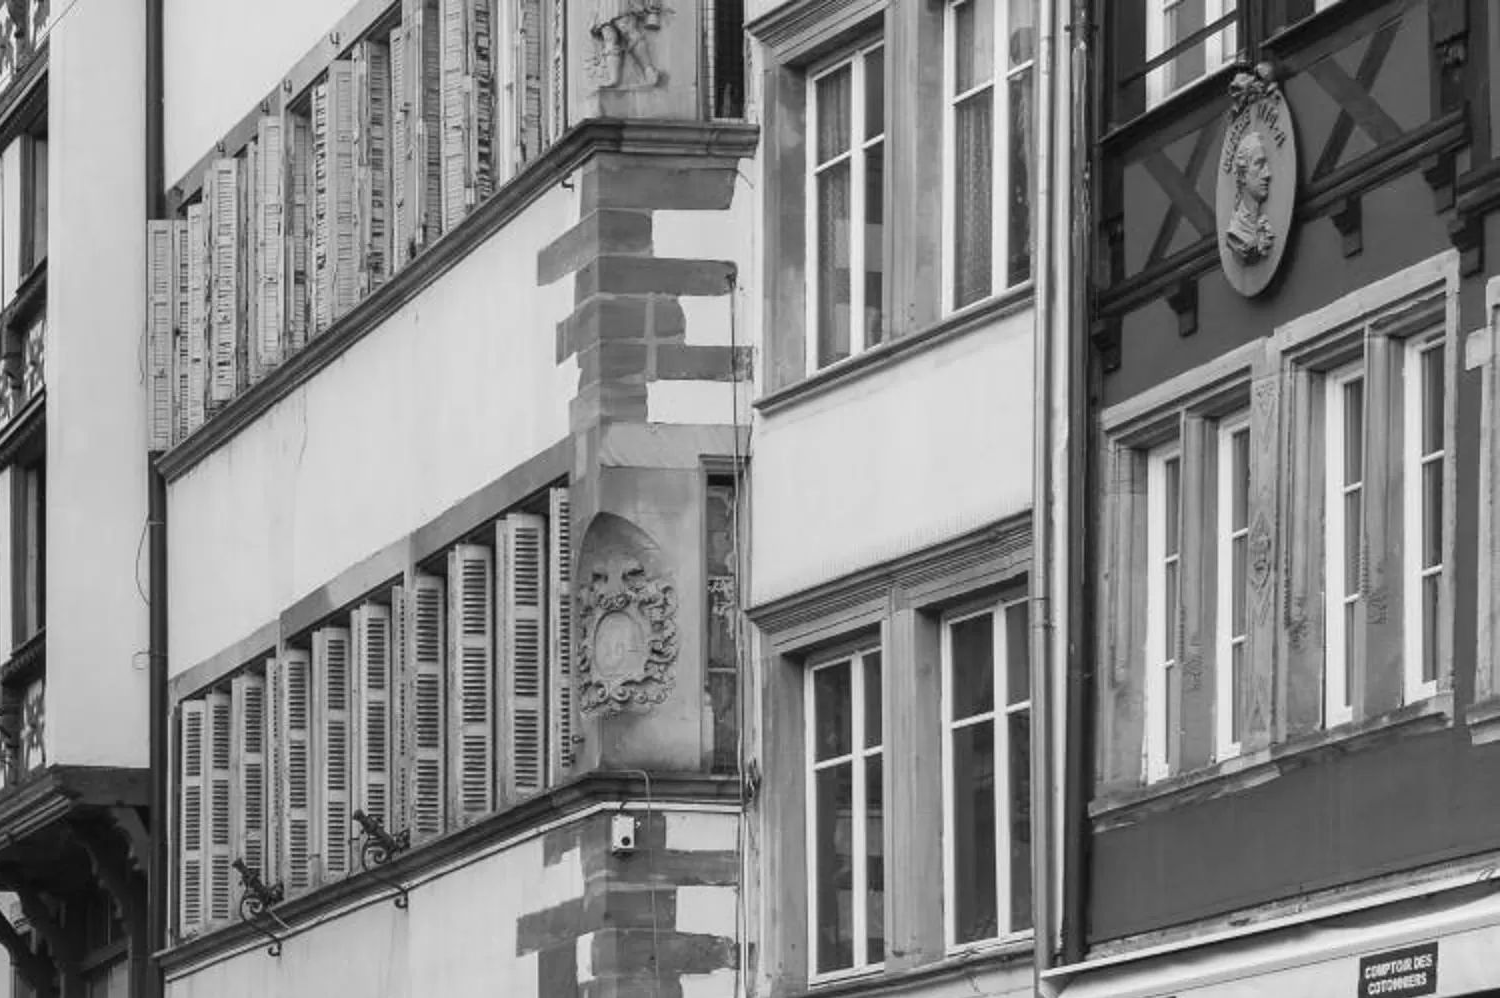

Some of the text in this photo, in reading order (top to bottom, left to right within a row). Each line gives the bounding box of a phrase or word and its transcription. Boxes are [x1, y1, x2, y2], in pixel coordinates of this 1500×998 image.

[1364, 953, 1433, 980] COMPTOIR DES
[1367, 972, 1427, 996] COTONNIERS
